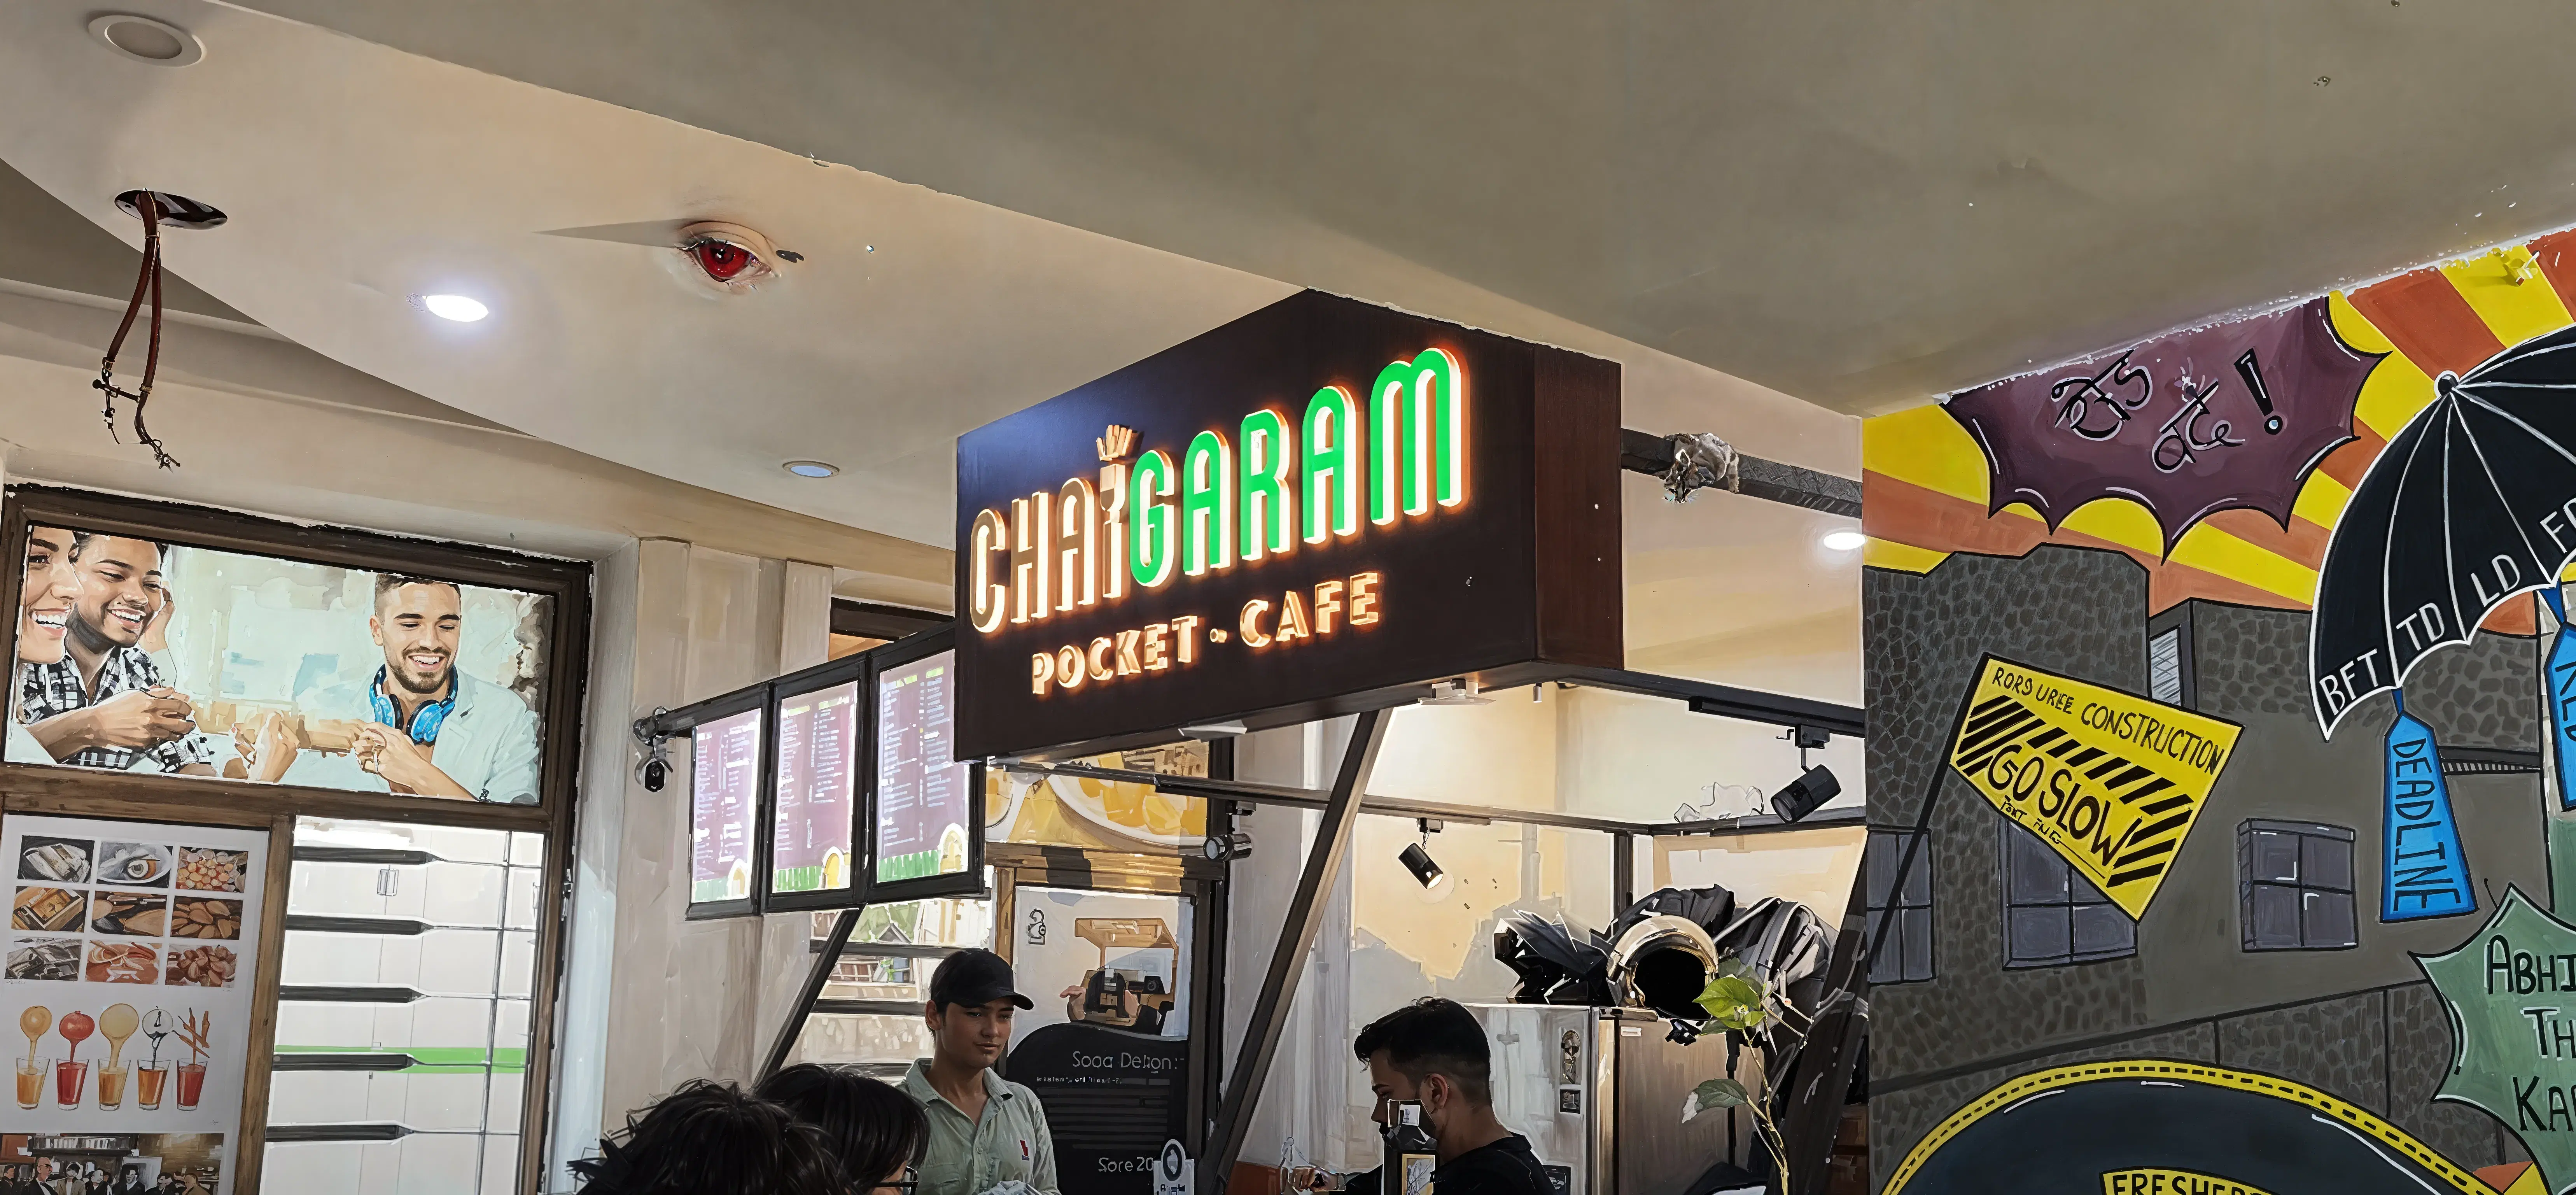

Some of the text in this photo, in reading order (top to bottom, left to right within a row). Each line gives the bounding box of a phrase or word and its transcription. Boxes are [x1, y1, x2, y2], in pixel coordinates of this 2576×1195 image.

[2471, 554, 2521, 608] LD
[1031, 571, 1380, 695] POCKET CAFE
[2396, 602, 2445, 652] TD
[2319, 648, 2378, 717] BFT
[2081, 702, 2226, 776] CONSTRUCTION
[1987, 744, 2144, 867] GO SLOW
[2392, 738, 2461, 912] DEADLINE
